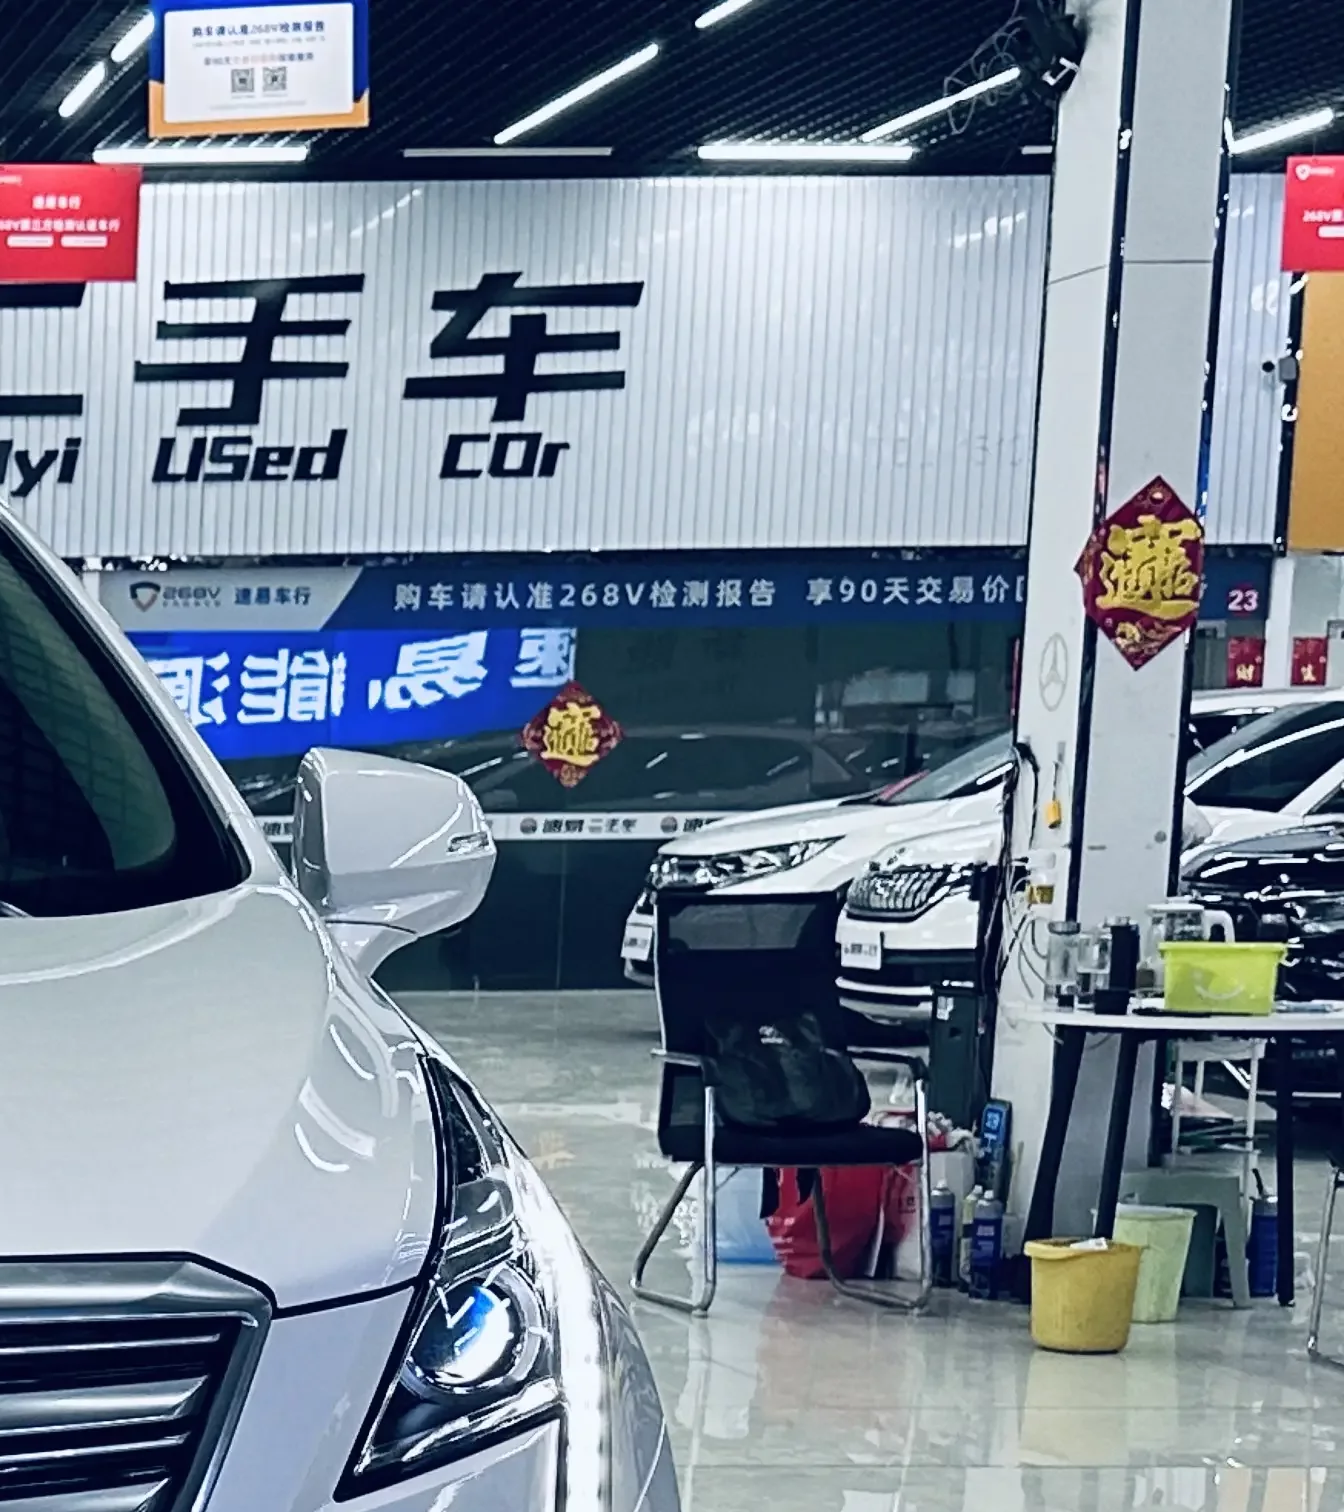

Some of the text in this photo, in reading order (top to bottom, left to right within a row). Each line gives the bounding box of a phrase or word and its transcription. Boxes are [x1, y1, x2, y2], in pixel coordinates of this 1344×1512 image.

[393, 579, 776, 612] 购车请认准268V检测报告
[1227, 589, 1259, 612] 23
